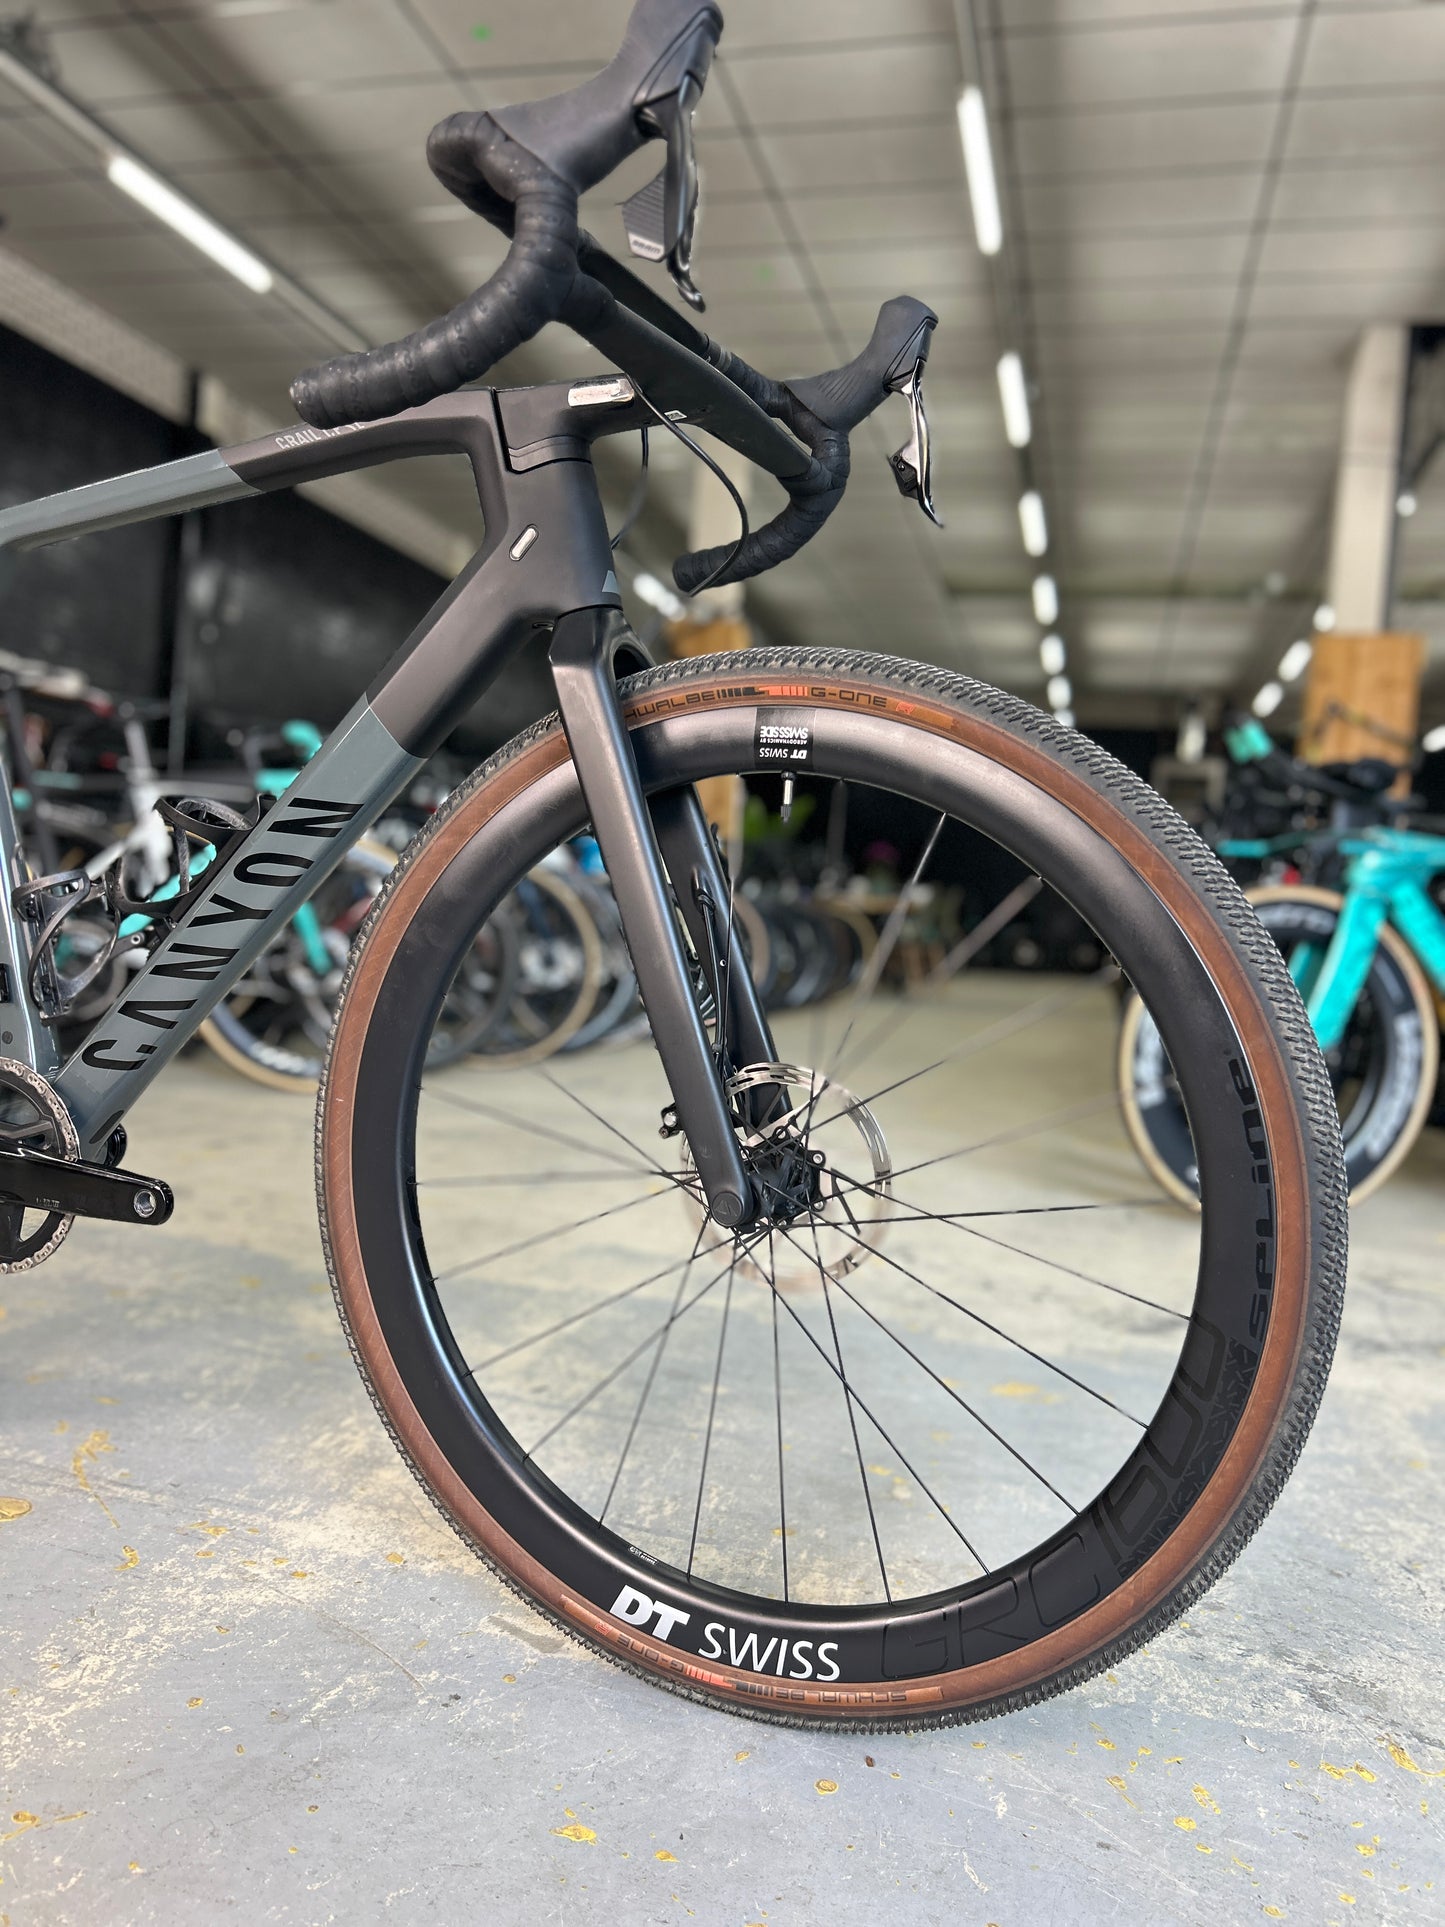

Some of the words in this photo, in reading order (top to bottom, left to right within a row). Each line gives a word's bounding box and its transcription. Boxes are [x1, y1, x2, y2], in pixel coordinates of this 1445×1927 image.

[275, 428, 322, 450] GRAIL
[810, 686, 888, 708] G-ONE
[759, 747, 789, 758] SWISS
[790, 749, 807, 759] DT
[82, 797, 364, 1070] CANYON
[609, 1584, 691, 1641] DT
[698, 1622, 841, 1682] SWISS
[616, 1633, 685, 1672] G-ONE
[775, 1688, 907, 1704] SCHWALBE
